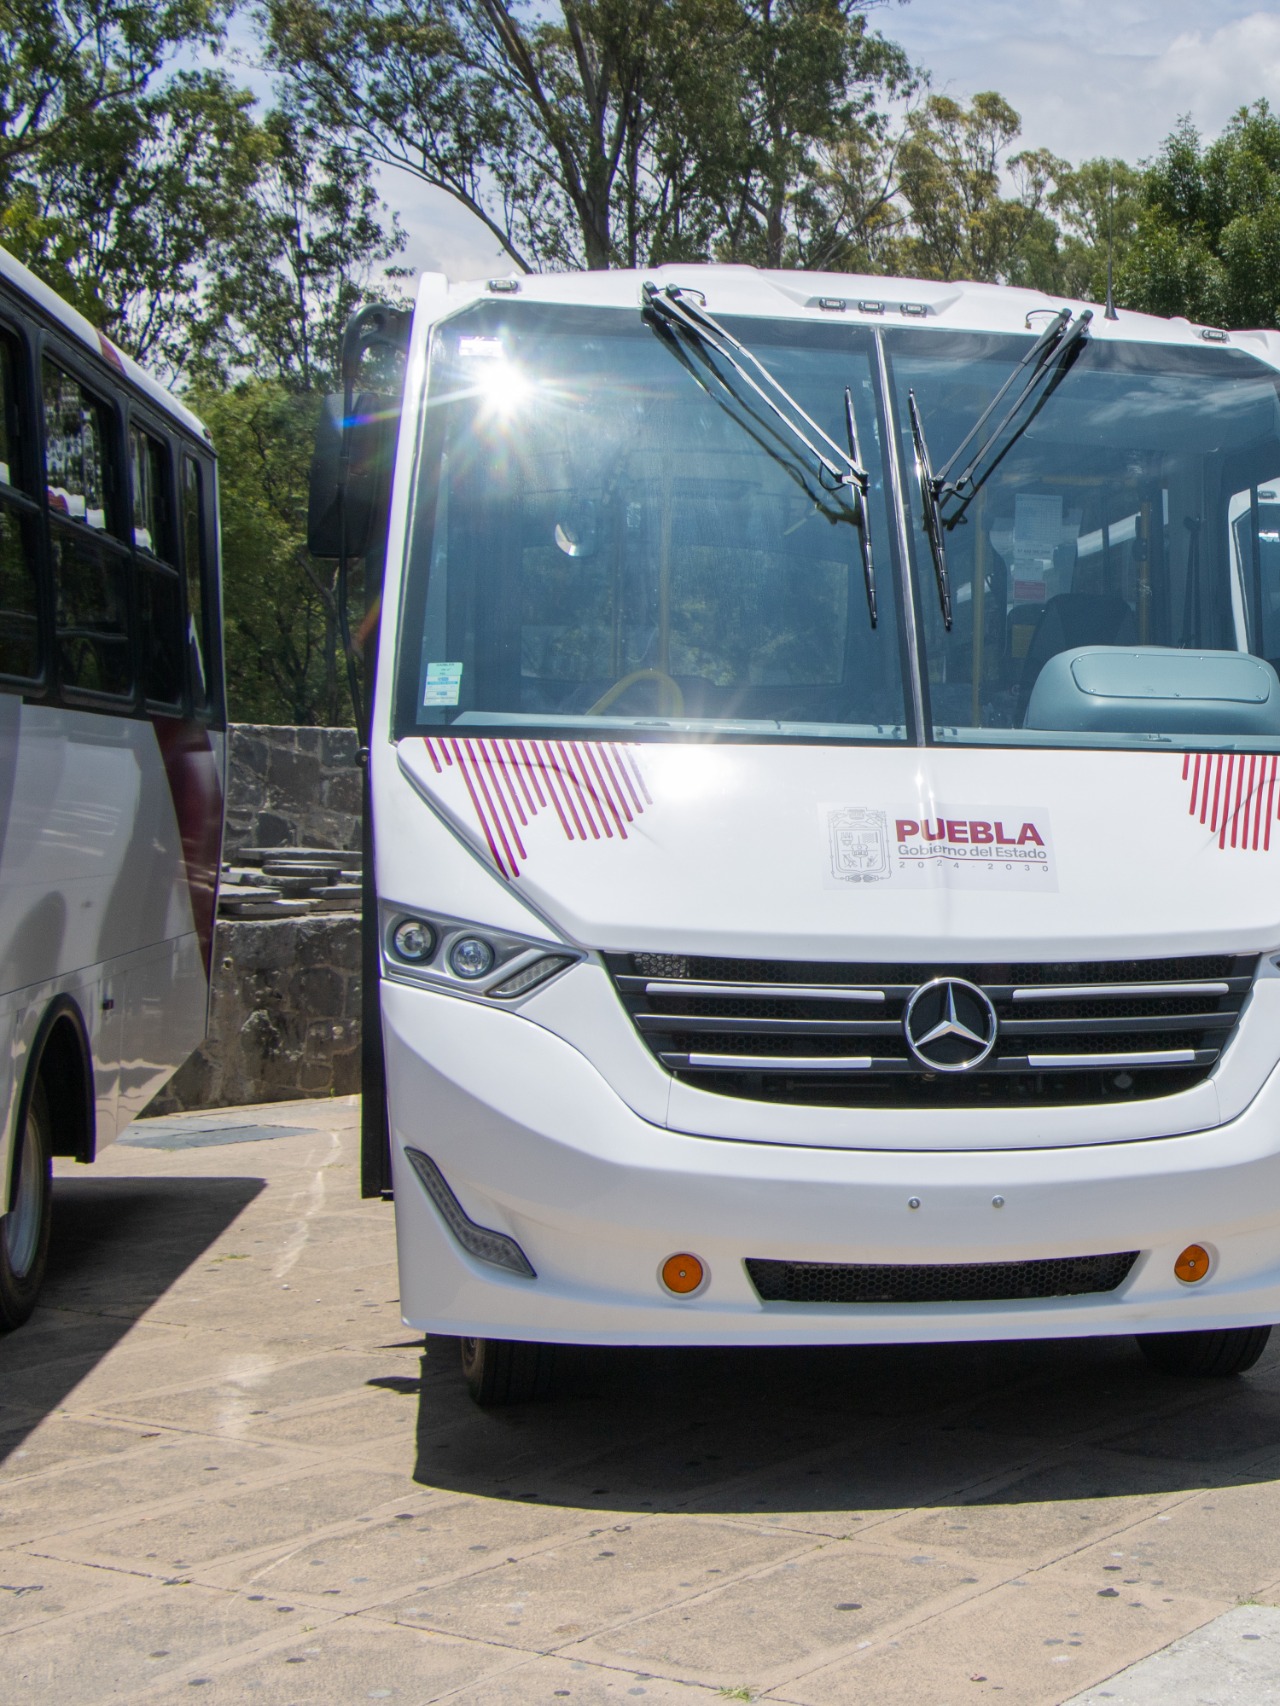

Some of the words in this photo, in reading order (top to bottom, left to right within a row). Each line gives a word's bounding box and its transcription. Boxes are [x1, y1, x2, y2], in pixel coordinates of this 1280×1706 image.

[895, 818, 1045, 846] PUEBLA
[897, 844, 967, 857] Gobierno
[969, 846, 993, 858] del
[995, 847, 1047, 860] Estado
